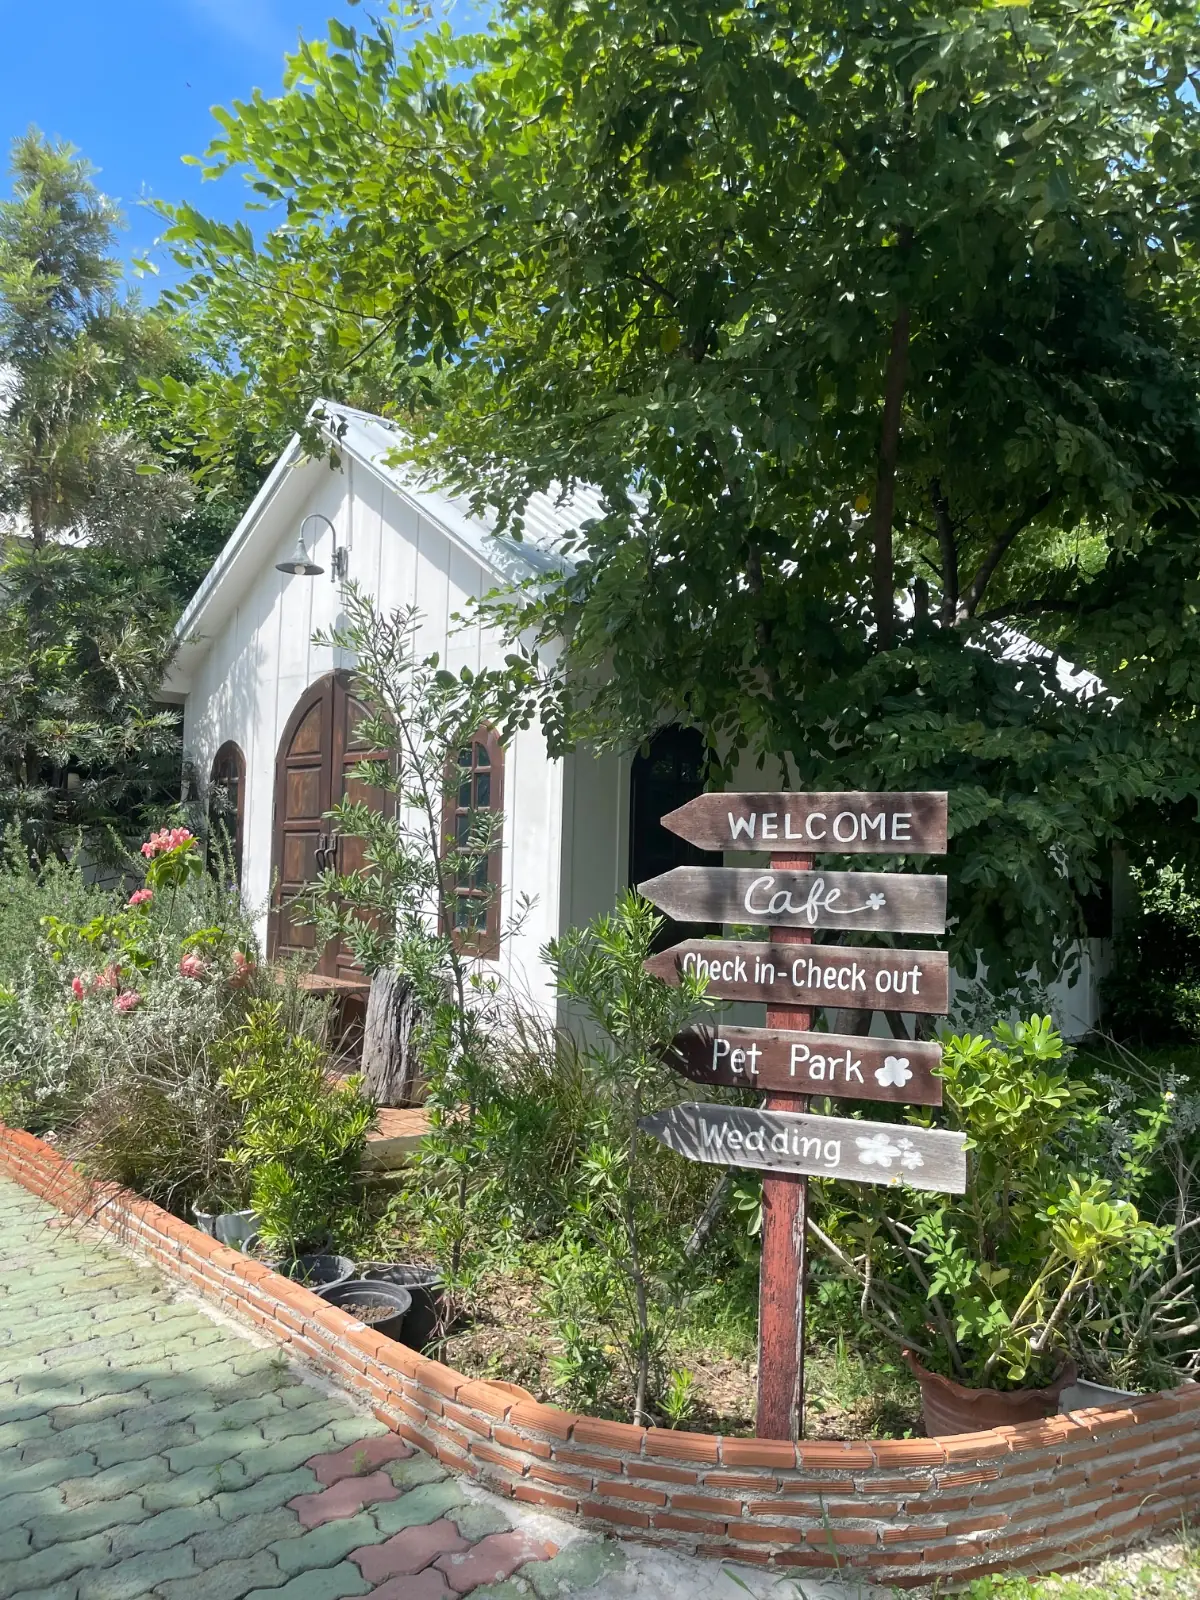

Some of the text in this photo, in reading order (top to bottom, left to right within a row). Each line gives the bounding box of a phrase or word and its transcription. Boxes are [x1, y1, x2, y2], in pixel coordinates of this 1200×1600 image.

[727, 811, 912, 843] WELCOME
[744, 876, 866, 925] Cafe
[875, 965, 923, 995] out
[712, 1038, 865, 1084] Pet Park
[699, 1118, 841, 1168] Wedding
